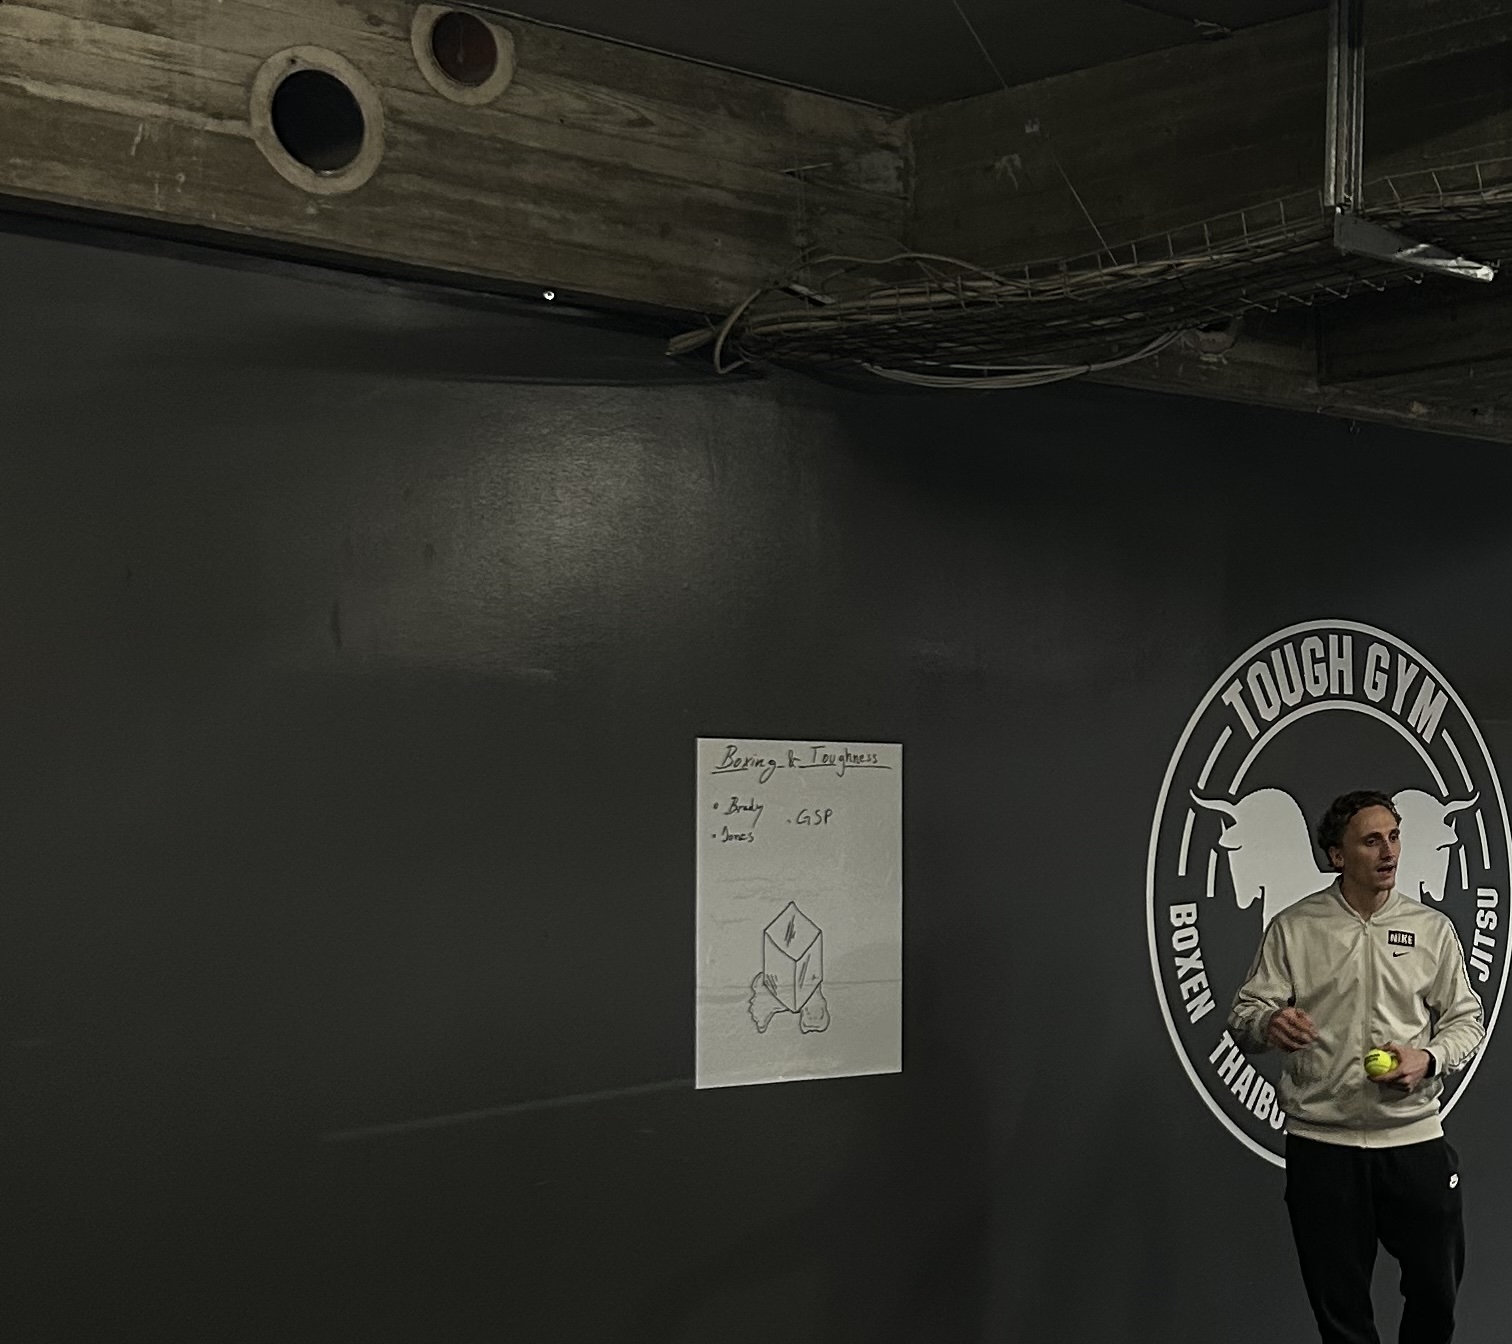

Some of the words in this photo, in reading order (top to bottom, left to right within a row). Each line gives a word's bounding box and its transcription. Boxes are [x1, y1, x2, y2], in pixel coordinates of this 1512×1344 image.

[1221, 634, 1353, 741] TOUGH
[1363, 641, 1450, 745] GYM
[716, 745, 778, 784] Boxing
[787, 749, 799, 769] &
[808, 745, 880, 778] Toughness
[724, 796, 764, 827] Brady
[796, 808, 834, 826] GSP
[1389, 932, 1414, 945] NIKE
[1469, 885, 1499, 984] JITSU
[1169, 902, 1216, 1025] BOXEN
